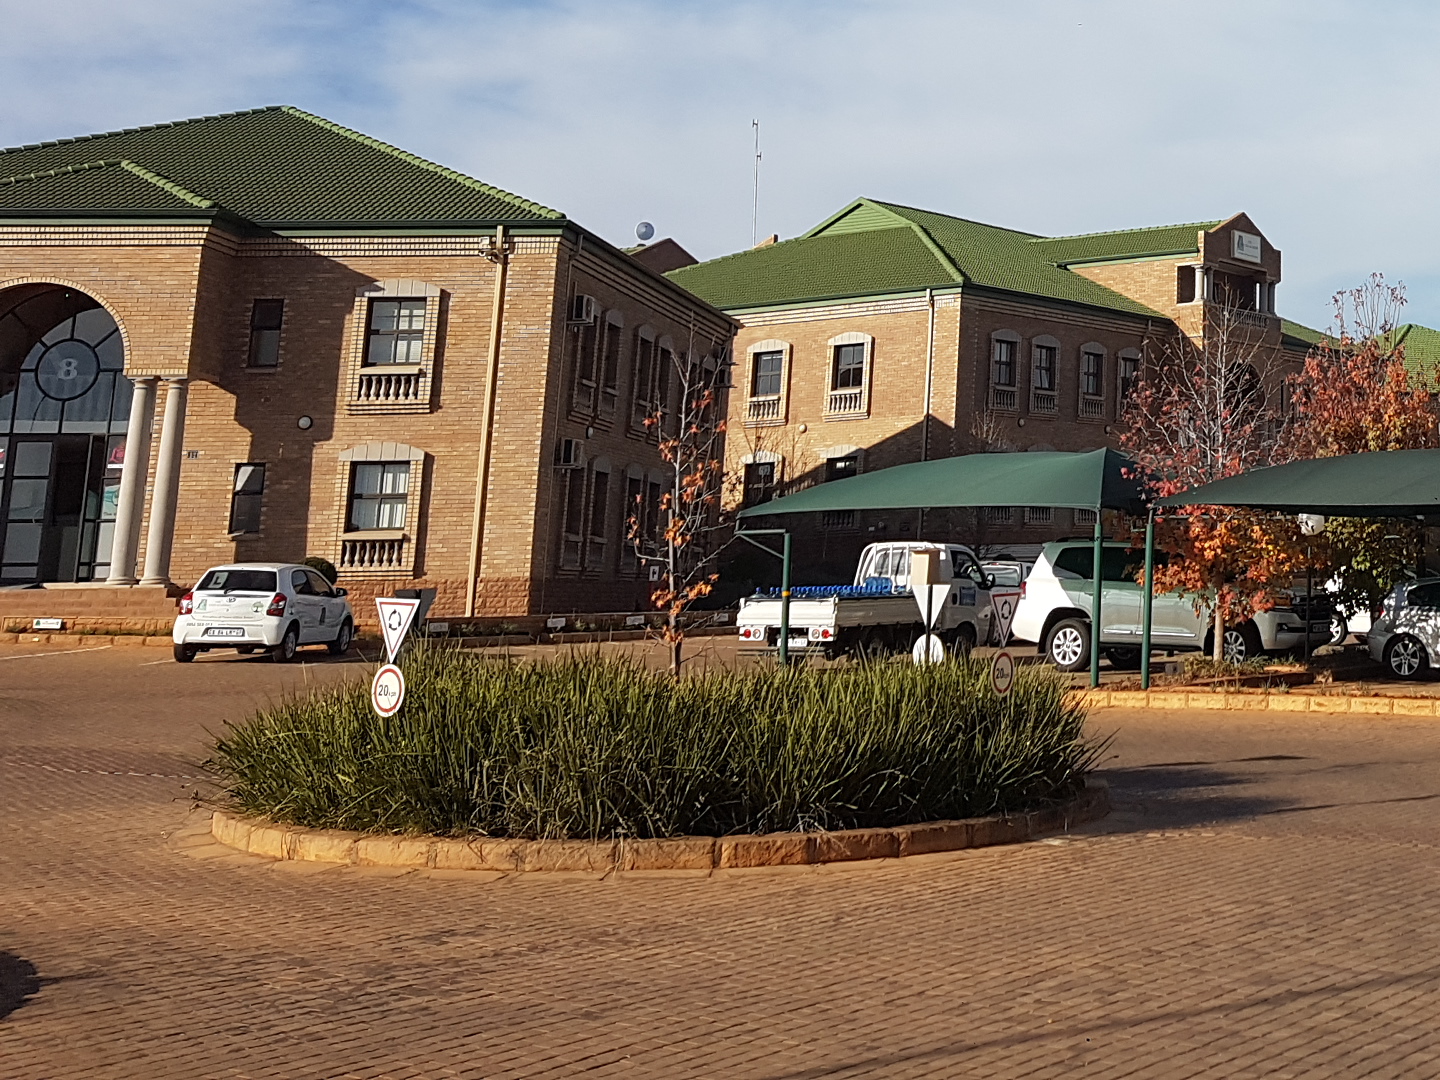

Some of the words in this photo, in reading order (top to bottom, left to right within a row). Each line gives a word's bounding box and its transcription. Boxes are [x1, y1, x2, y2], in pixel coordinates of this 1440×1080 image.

[57, 358, 78, 380] 8
[213, 576, 222, 585] L
[996, 667, 1005, 679] 20
[378, 684, 389, 697] 20
